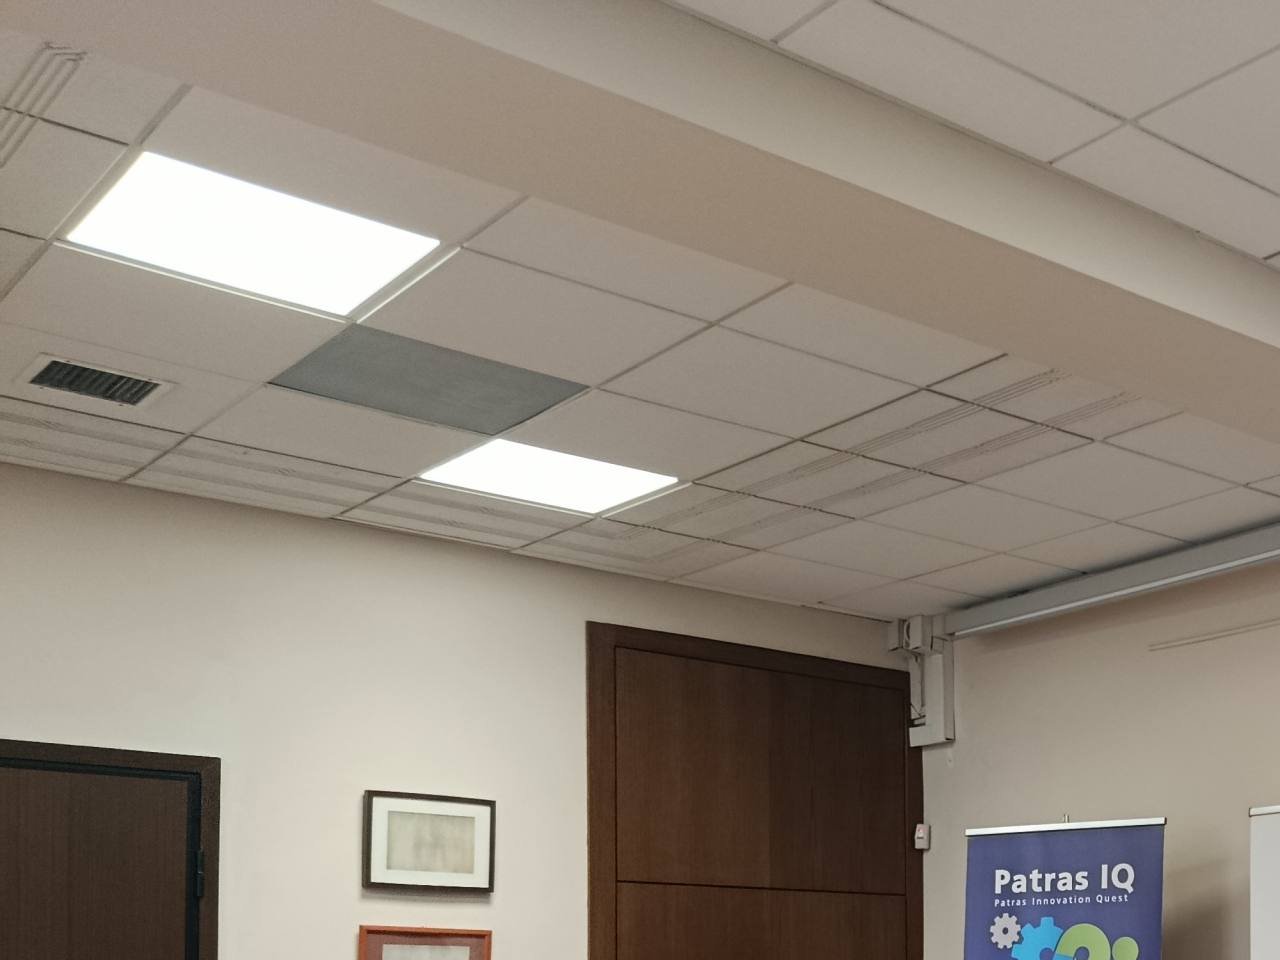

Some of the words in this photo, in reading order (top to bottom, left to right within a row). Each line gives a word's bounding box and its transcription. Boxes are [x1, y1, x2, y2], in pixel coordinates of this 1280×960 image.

[994, 868, 1089, 894] Patras
[1101, 863, 1135, 893] IQ
[994, 897, 1027, 907] Patras
[1032, 895, 1091, 905] Innovation
[1096, 894, 1129, 903] Quest
